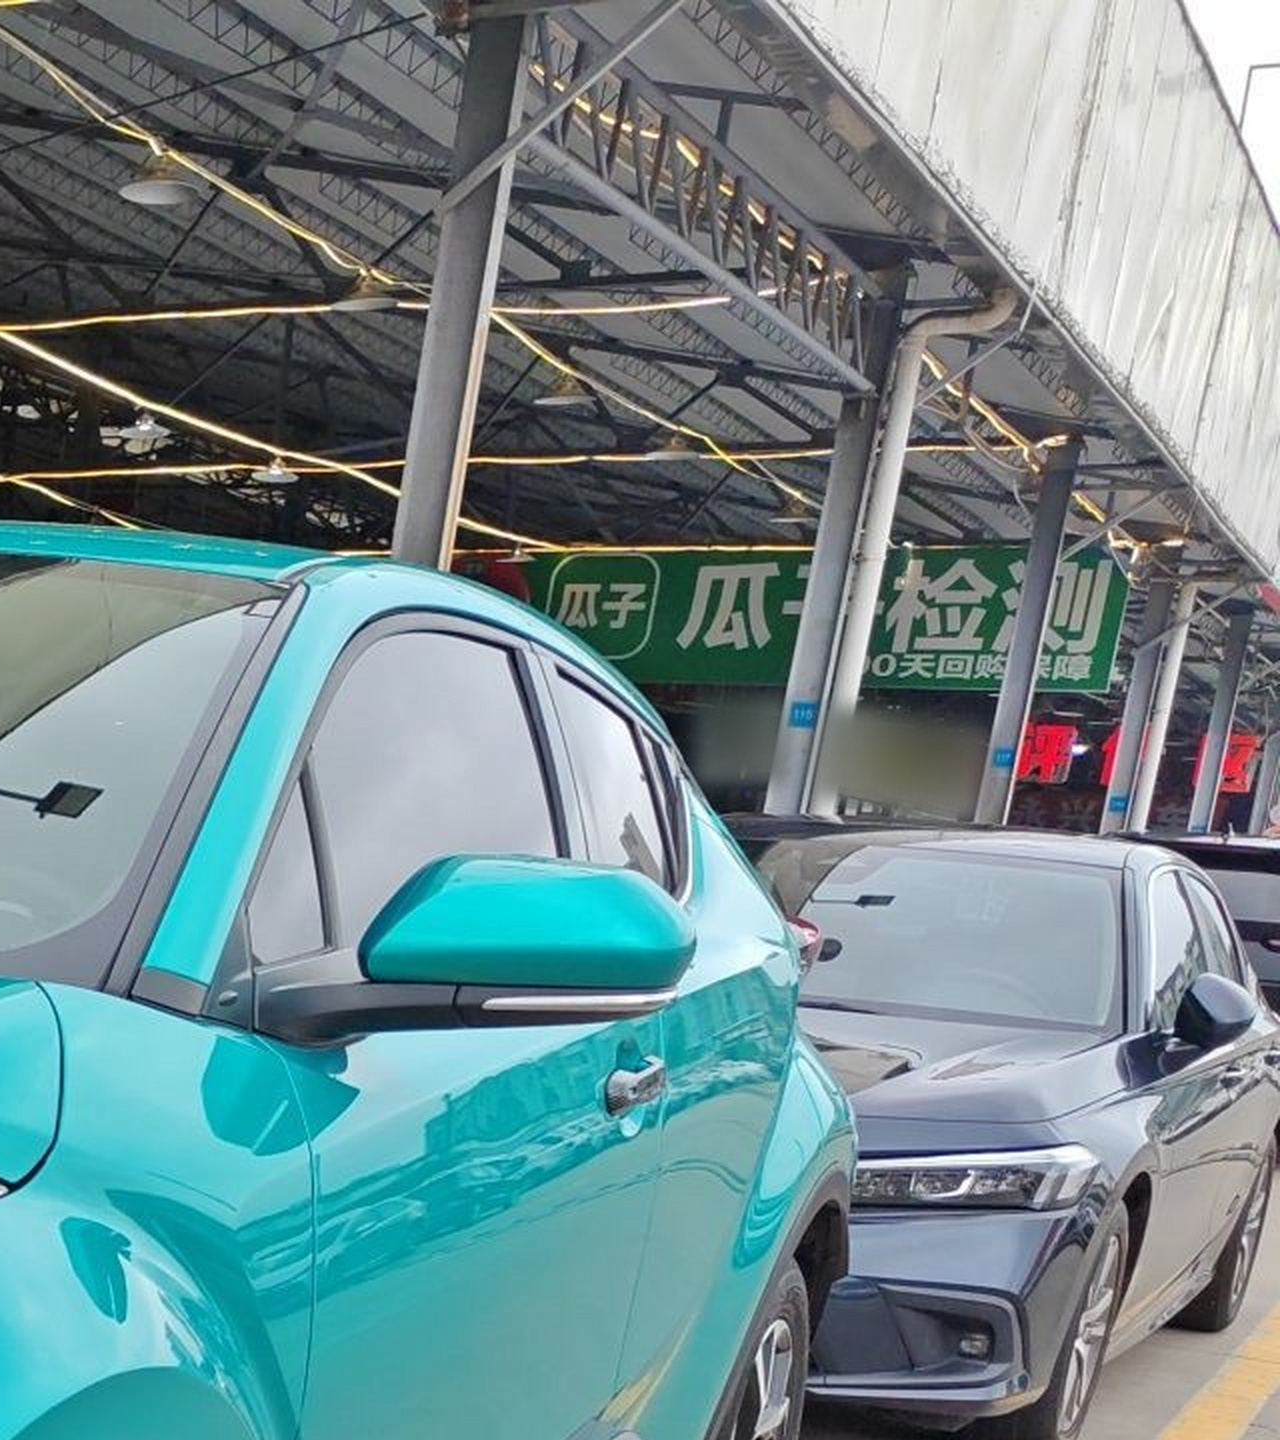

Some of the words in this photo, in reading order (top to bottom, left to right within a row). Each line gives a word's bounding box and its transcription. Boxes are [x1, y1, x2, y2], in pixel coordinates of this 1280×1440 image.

[556, 583, 646, 629] 瓜子
[676, 558, 1113, 655] 瓜检测
